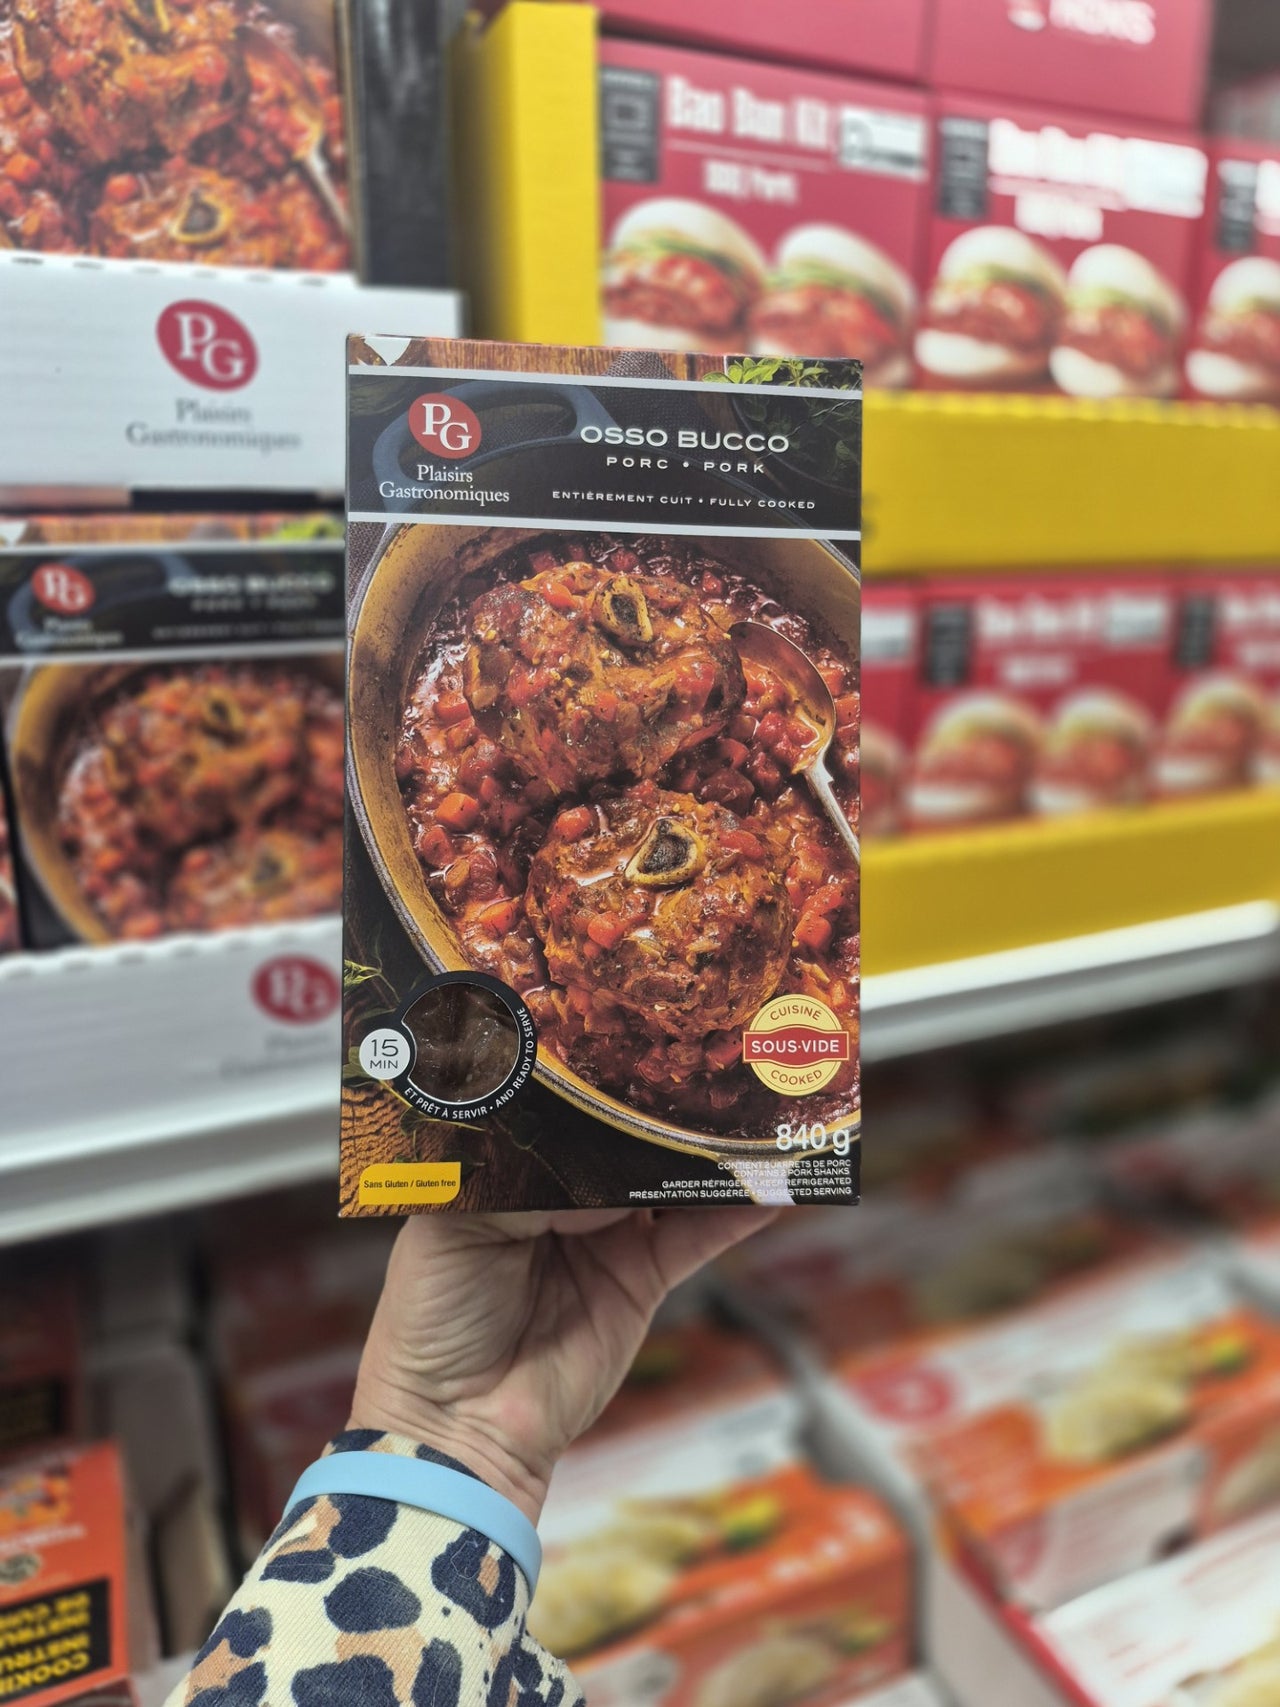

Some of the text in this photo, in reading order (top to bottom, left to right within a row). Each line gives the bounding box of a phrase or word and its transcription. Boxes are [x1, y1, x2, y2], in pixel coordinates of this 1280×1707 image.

[174, 311, 247, 382] PG
[176, 398, 251, 425] Plaisirs
[421, 403, 472, 451] PG
[580, 426, 790, 453] OSSO BUCCO
[416, 464, 474, 483] Plaisirs
[606, 456, 765, 474] PORC PORK
[379, 481, 511, 507] Gastronomiques
[659, 496, 693, 505] CUIT
[709, 498, 752, 507] FULLY
[757, 500, 816, 510] COOKED
[370, 1039, 399, 1057] 15
[369, 1059, 399, 1070] MIN
[404, 1007, 535, 1120] ET PRÊT À SERVIR AND READY TO SERVE
[770, 1069, 823, 1086] COOKED
[775, 1124, 851, 1156] 840 g
[717, 1161, 764, 1170] CONTIENT
[813, 1160, 826, 1168] DE
[826, 1159, 852, 1168] PORC
[787, 1168, 813, 1177] PORK
[813, 1167, 850, 1176] SHANKS
[363, 1180, 384, 1188] Sans
[384, 1179, 409, 1188] Gluten
[415, 1179, 440, 1188] Gluten
[440, 1178, 457, 1188] free
[662, 1180, 700, 1189] GARDER
[784, 1177, 852, 1186] REFRIGERATED
[629, 1188, 699, 1199] PRÉSENTATION
[757, 1187, 812, 1197] SUGGESTED
[813, 1186, 852, 1196] SERVING
